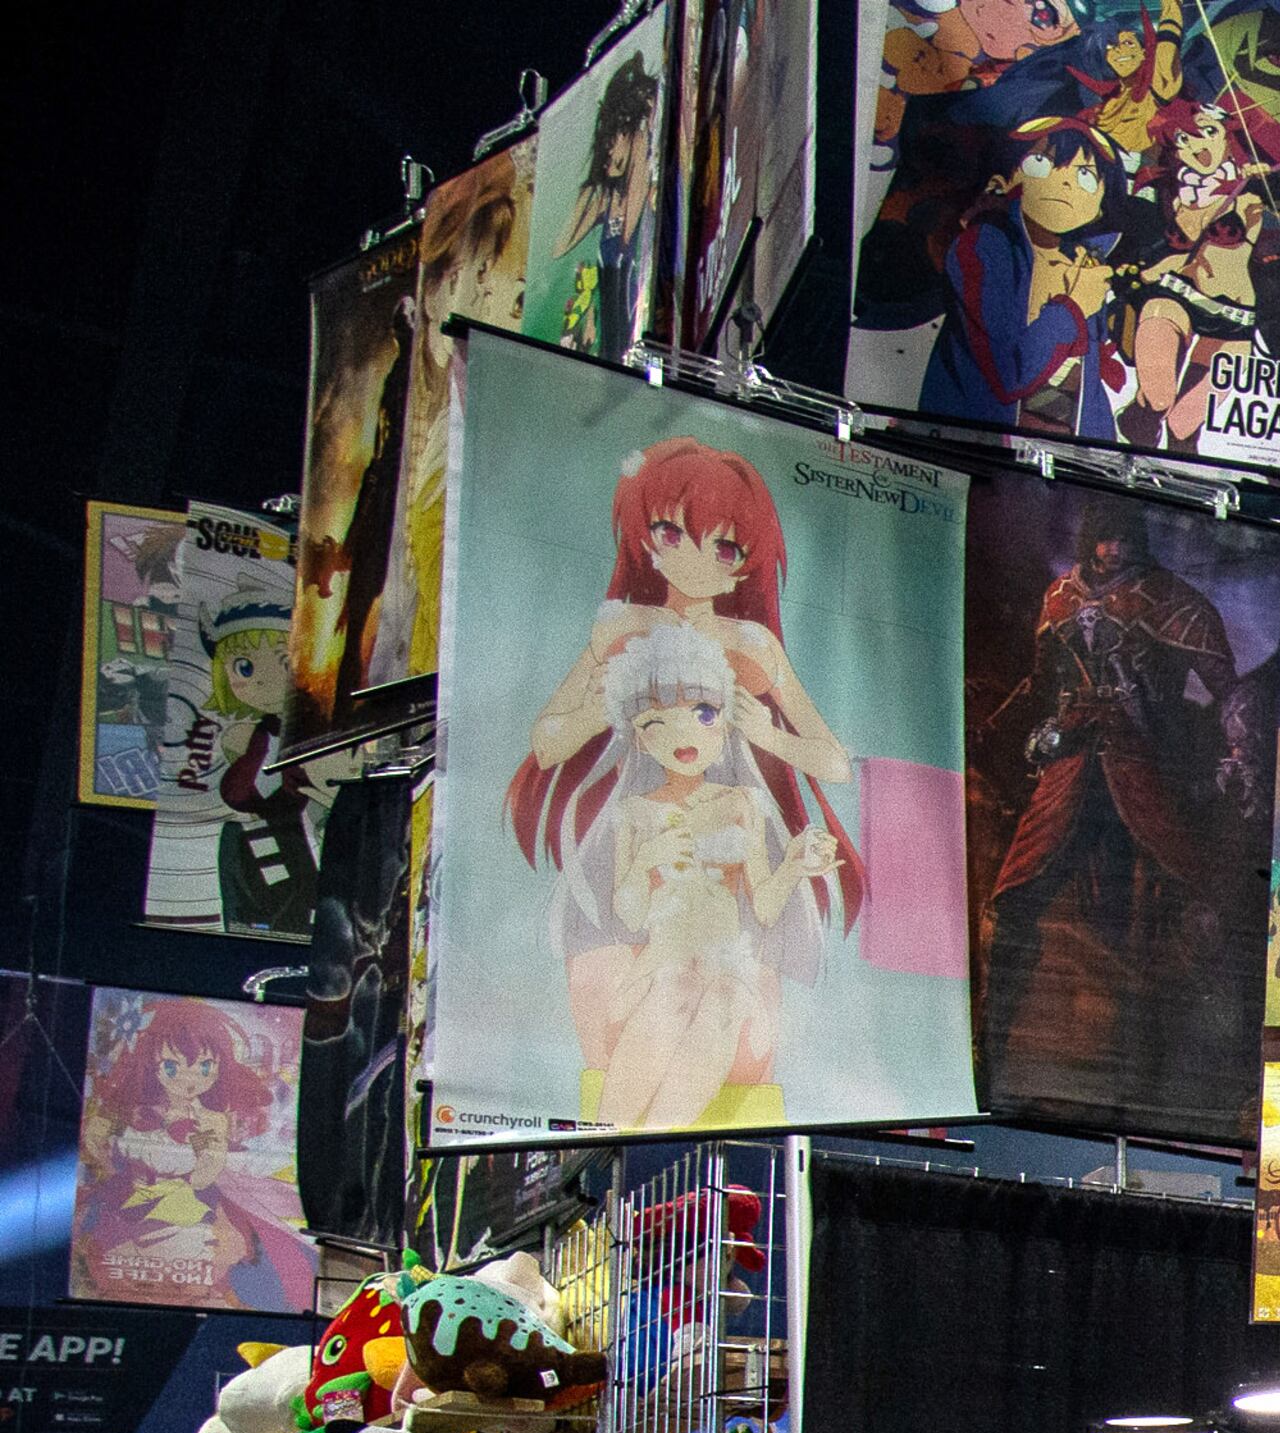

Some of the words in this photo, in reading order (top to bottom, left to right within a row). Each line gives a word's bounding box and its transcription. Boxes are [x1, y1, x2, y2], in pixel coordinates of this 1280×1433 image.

[839, 442, 943, 488] TESTAMENT
[176, 716, 222, 783] Patty
[459, 1111, 542, 1129] crunchyroll
[27, 1335, 126, 1365] APP!
[8, 1387, 38, 1403] AT
